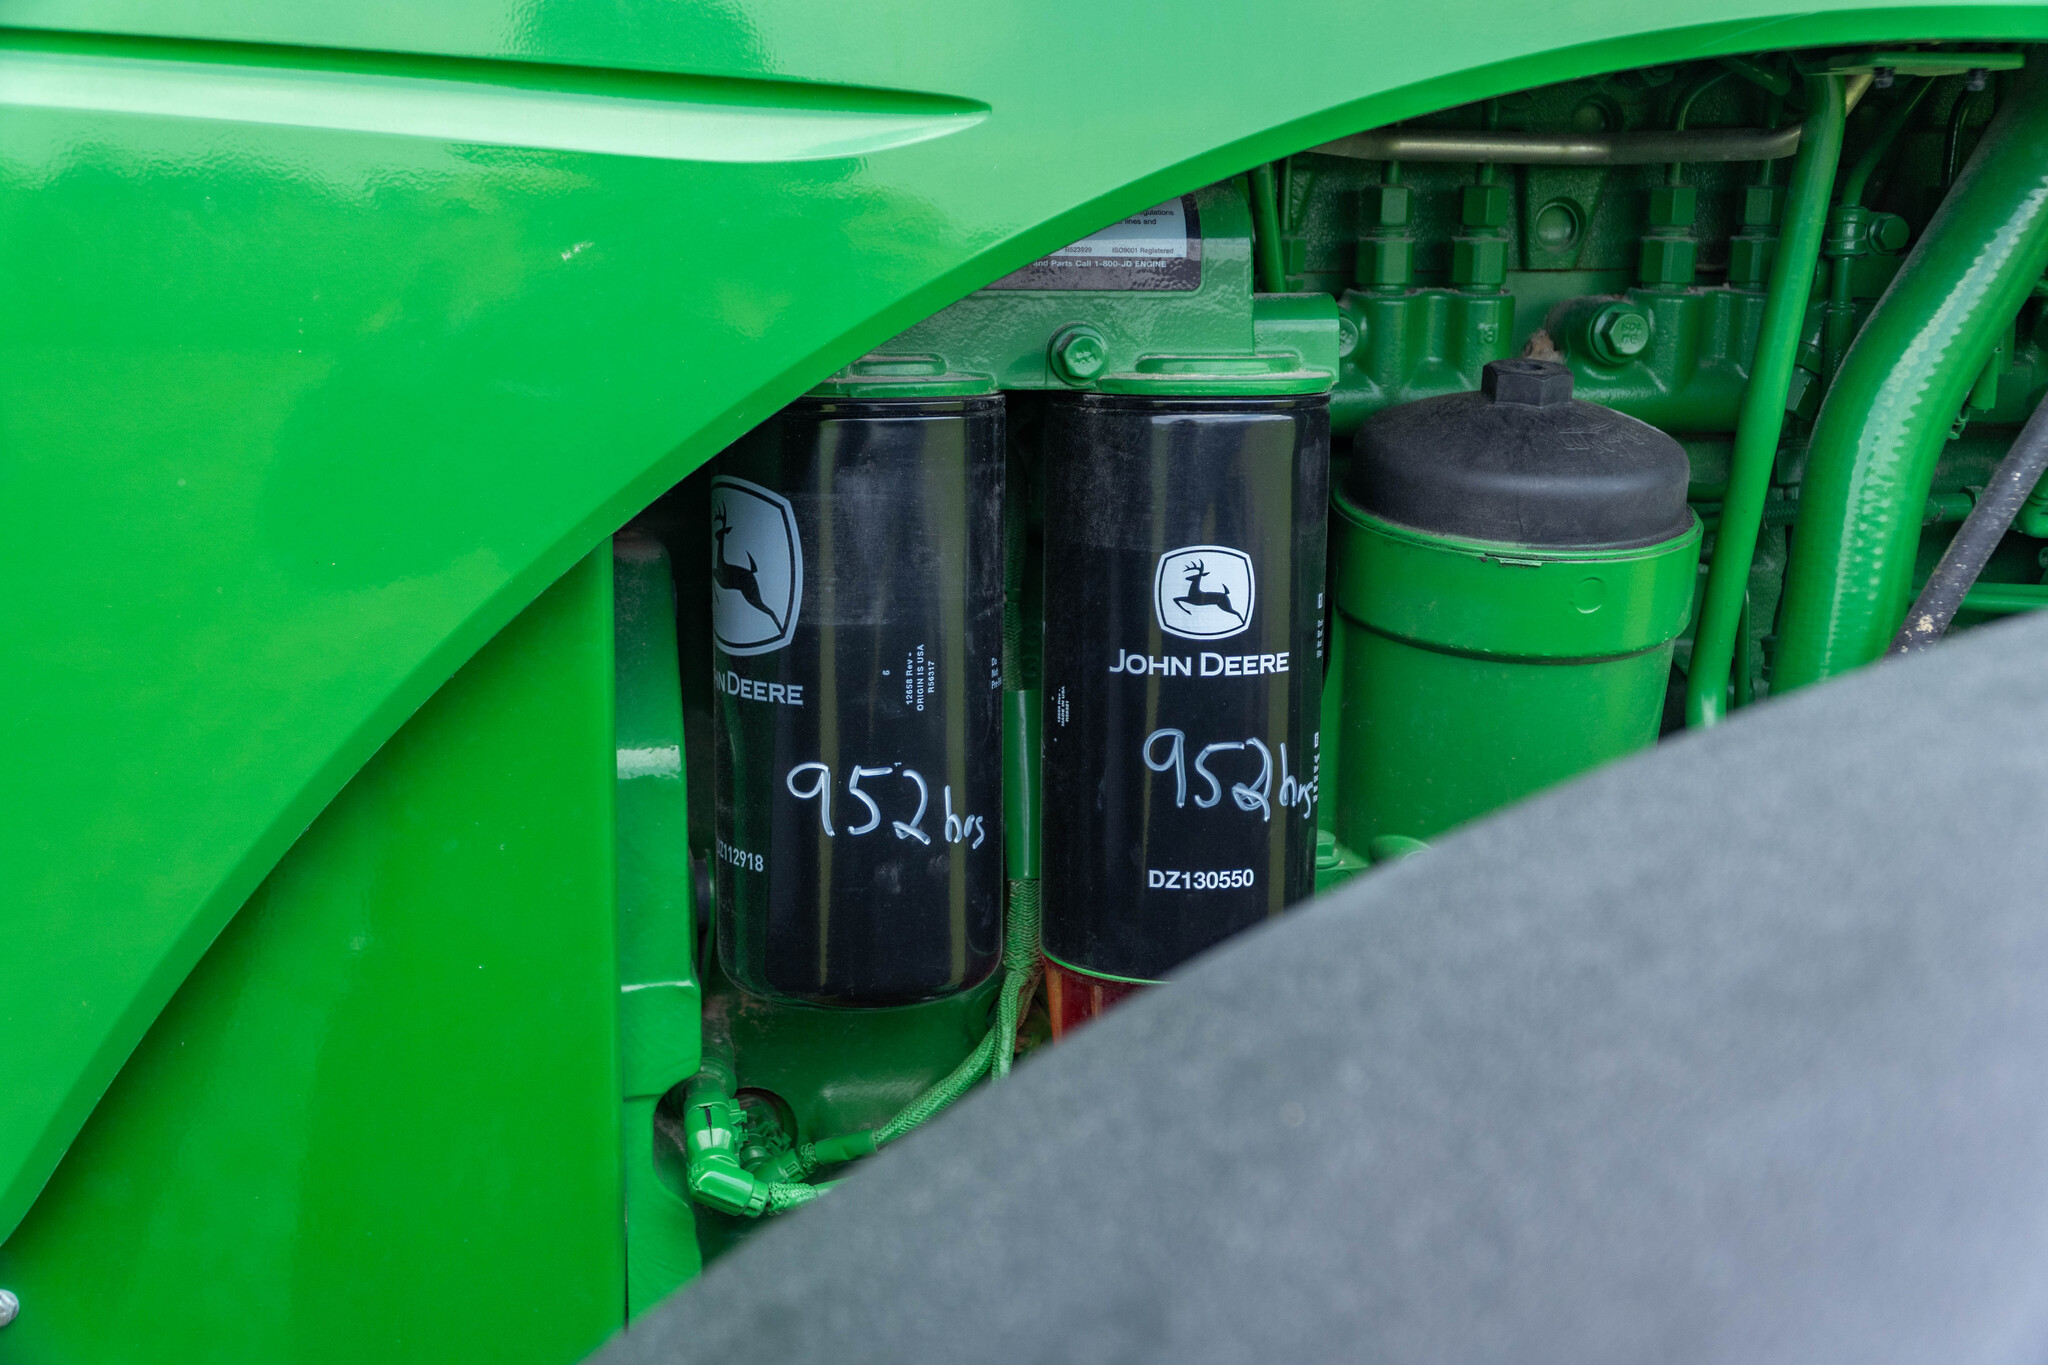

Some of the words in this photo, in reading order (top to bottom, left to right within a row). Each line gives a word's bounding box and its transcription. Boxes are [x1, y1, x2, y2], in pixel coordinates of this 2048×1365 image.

[1139, 209, 1175, 217] gulations
[1139, 247, 1175, 255] Registered
[1051, 259, 1073, 267] Parts
[1075, 259, 1092, 267] Call
[1094, 260, 1132, 268] 1-800-JD
[1134, 260, 1167, 268] ENGINE
[917, 643, 925, 664] USA
[1109, 648, 1192, 677] JOHN
[1200, 651, 1290, 677] DEERE
[917, 666, 924, 676] IS
[727, 670, 804, 706] DEERE
[1143, 728, 1273, 822] 952
[1279, 742, 1313, 820] hrs
[787, 761, 931, 845] 952
[945, 785, 985, 849] hrs
[1148, 868, 1255, 890] DZ130550
